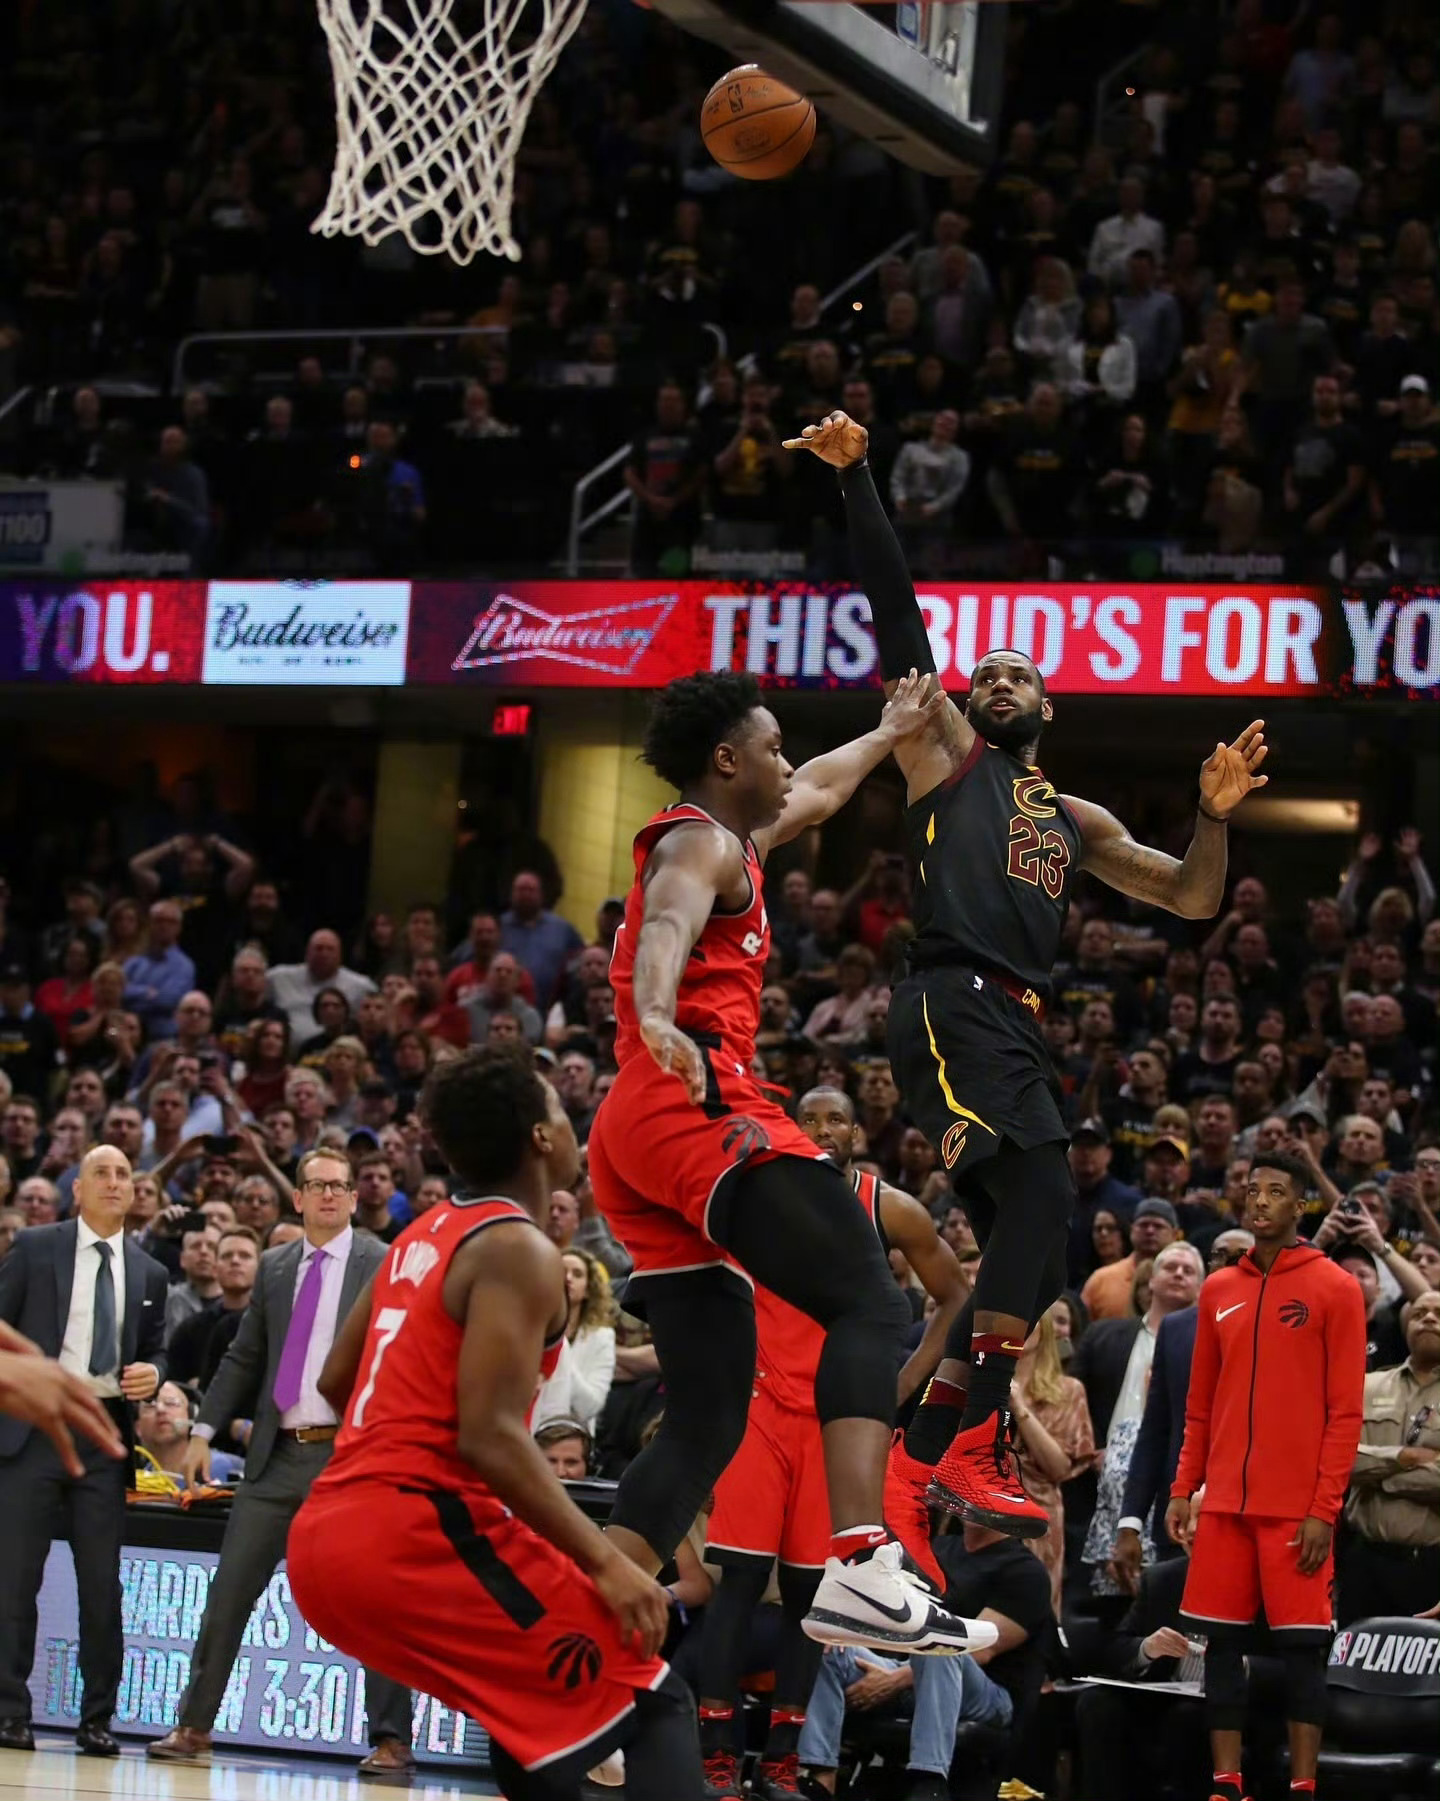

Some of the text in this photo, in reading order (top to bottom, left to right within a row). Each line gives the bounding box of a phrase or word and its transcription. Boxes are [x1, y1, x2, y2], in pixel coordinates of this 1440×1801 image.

[16, 591, 170, 672] YOU.
[214, 602, 399, 651] Budweiser
[478, 612, 652, 651] Budweiser
[703, 593, 877, 680] THIS
[910, 594, 1142, 682] BUD'S
[1161, 596, 1323, 684] FOR
[1007, 813, 1071, 899] 23
[352, 1307, 408, 1428] 7
